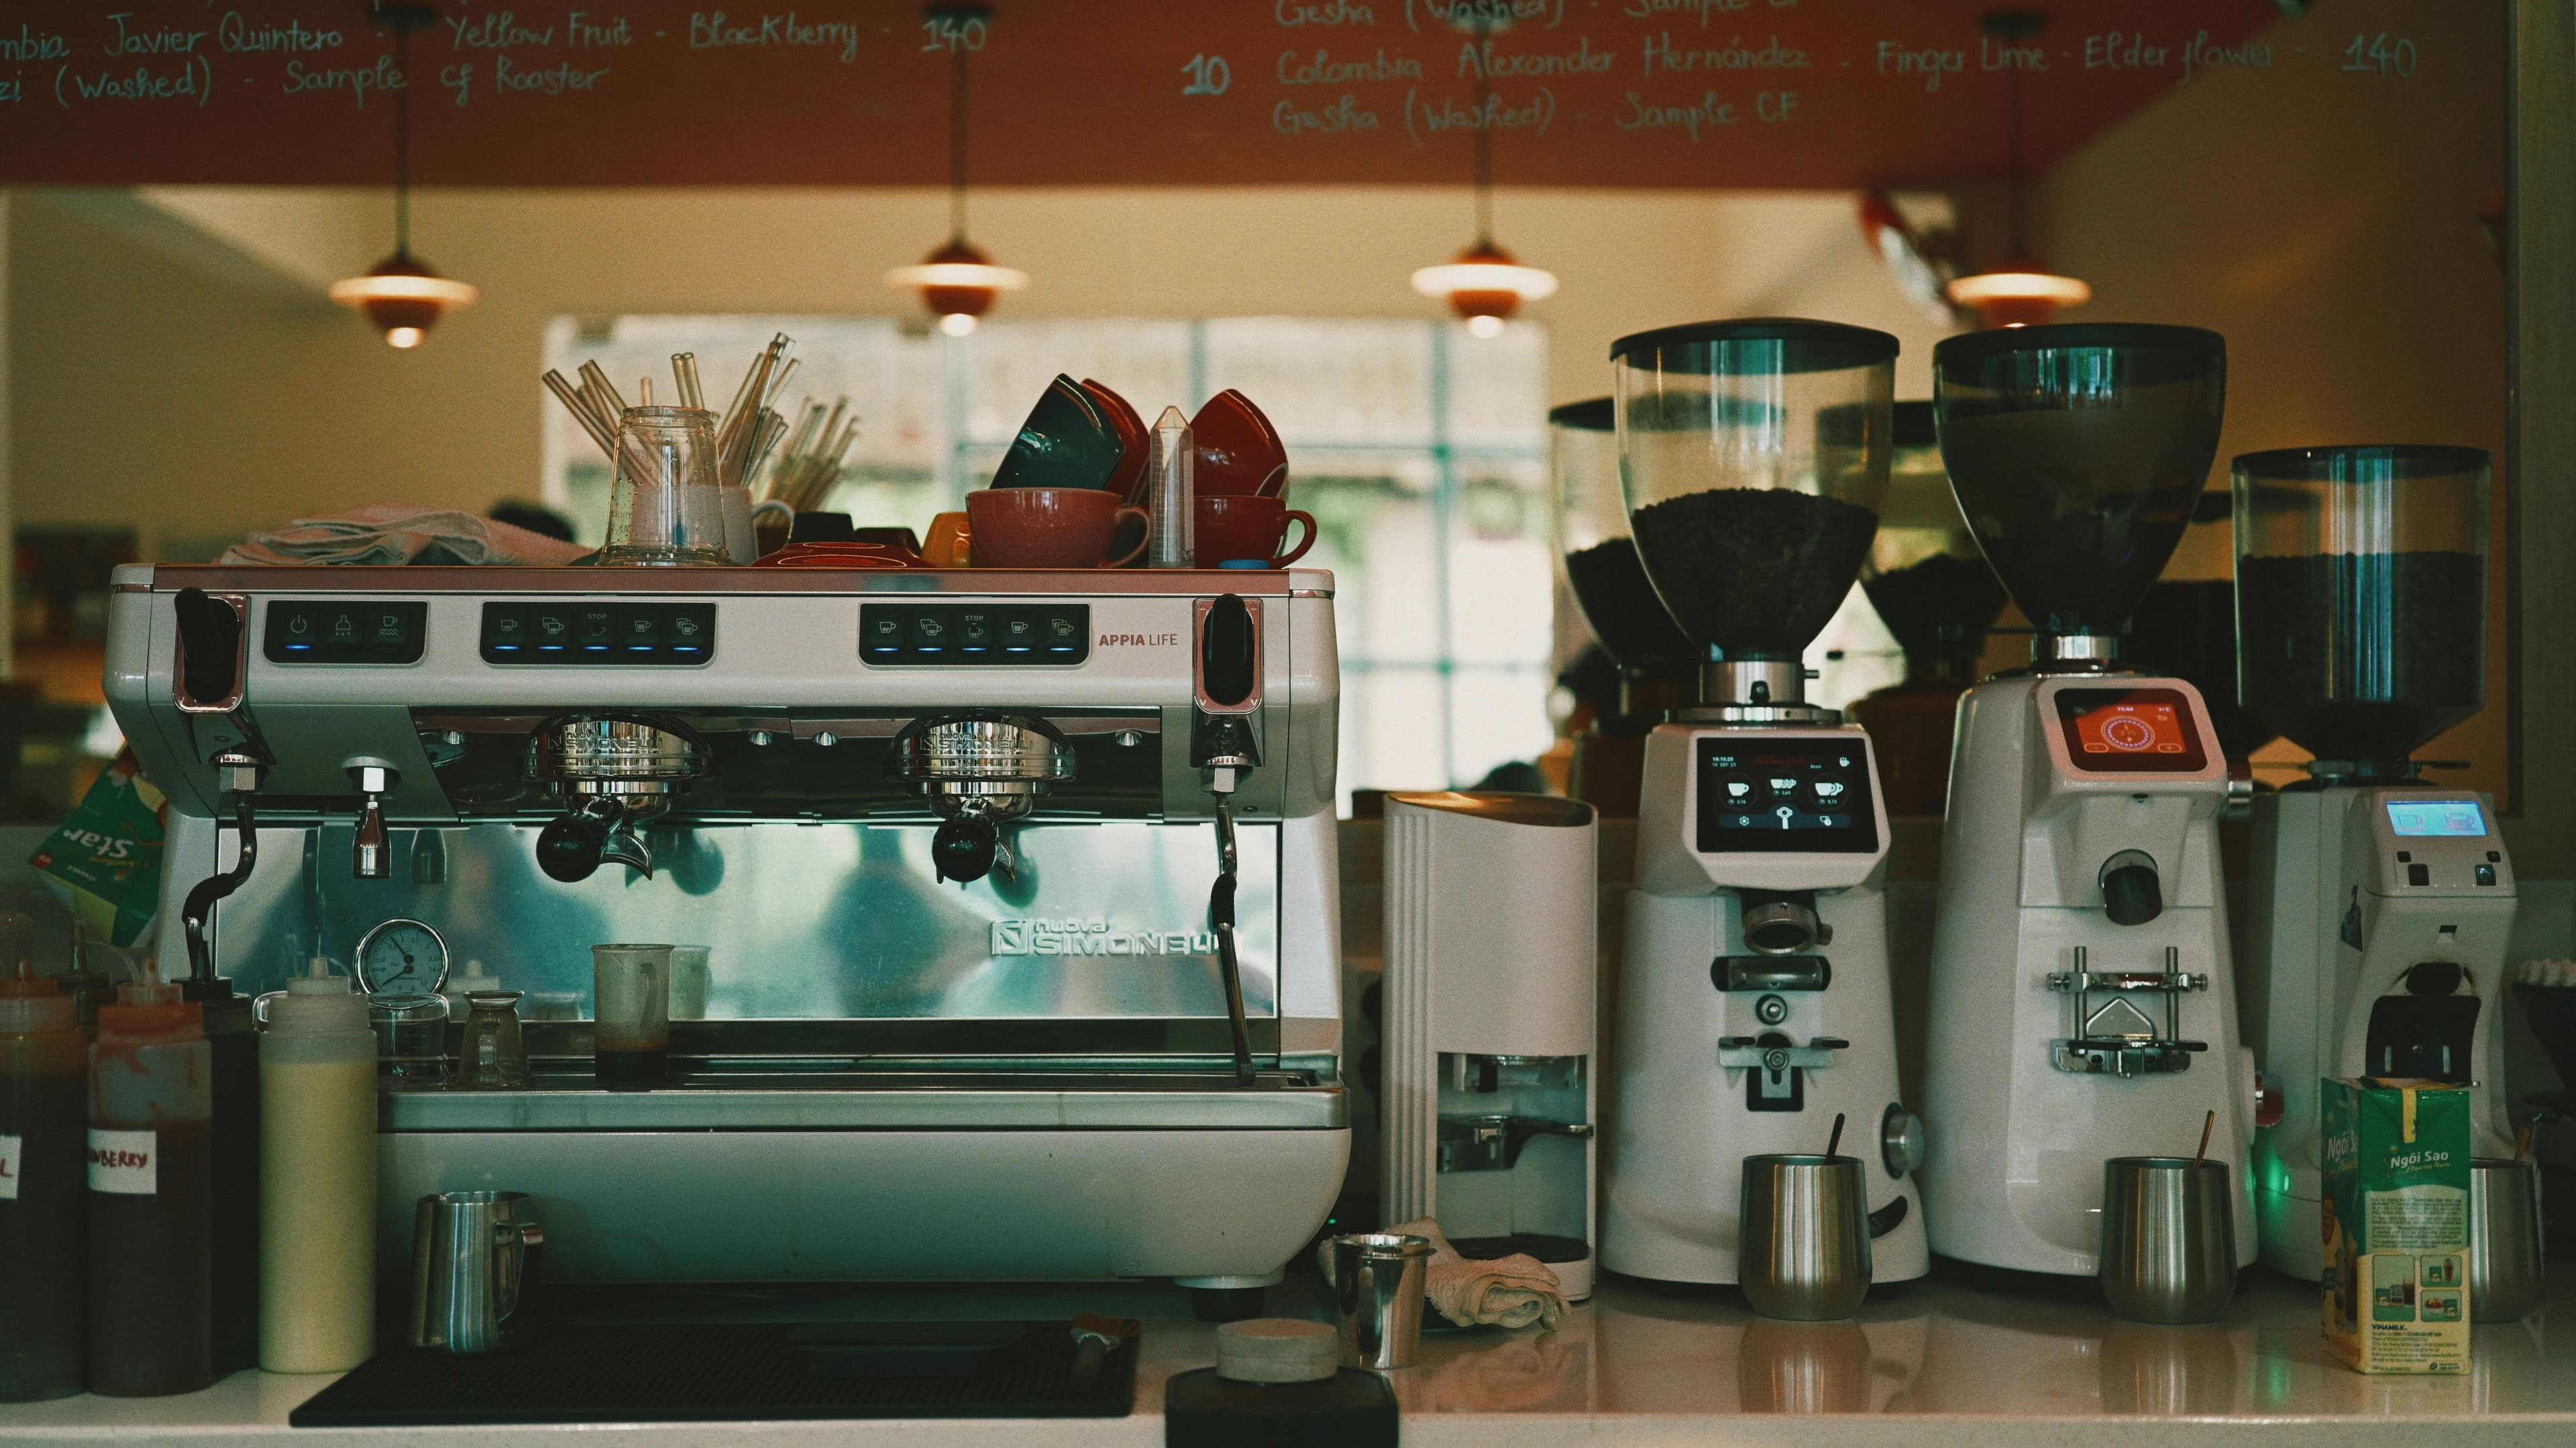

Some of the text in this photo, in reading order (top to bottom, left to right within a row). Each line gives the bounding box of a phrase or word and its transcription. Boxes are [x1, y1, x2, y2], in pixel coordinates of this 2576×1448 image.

[104, 12, 209, 58] Javier
[219, 11, 343, 53] Quintero
[444, 10, 554, 50] Yellow
[568, 11, 633, 47] Fruit
[920, 17, 987, 52] 140
[1181, 52, 1231, 96] 10
[1277, 47, 1424, 87] Colombia
[1456, 36, 1613, 79] Alexander
[1980, 38, 2051, 72] Lime
[2341, 32, 2418, 78] 140
[55, 54, 211, 107] (Washed)
[282, 56, 408, 109] Sample
[495, 54, 612, 95] Roaster
[1614, 90, 1739, 144] Sample
[1098, 633, 1178, 646] APPIA LIFE
[938, 740, 1034, 752] SIMONELLI
[63, 827, 134, 859] Star
[1034, 917, 1110, 934] nuova
[1034, 932, 1245, 957] SIMONELI
[2390, 1151, 2449, 1169] Ngôi Sao
